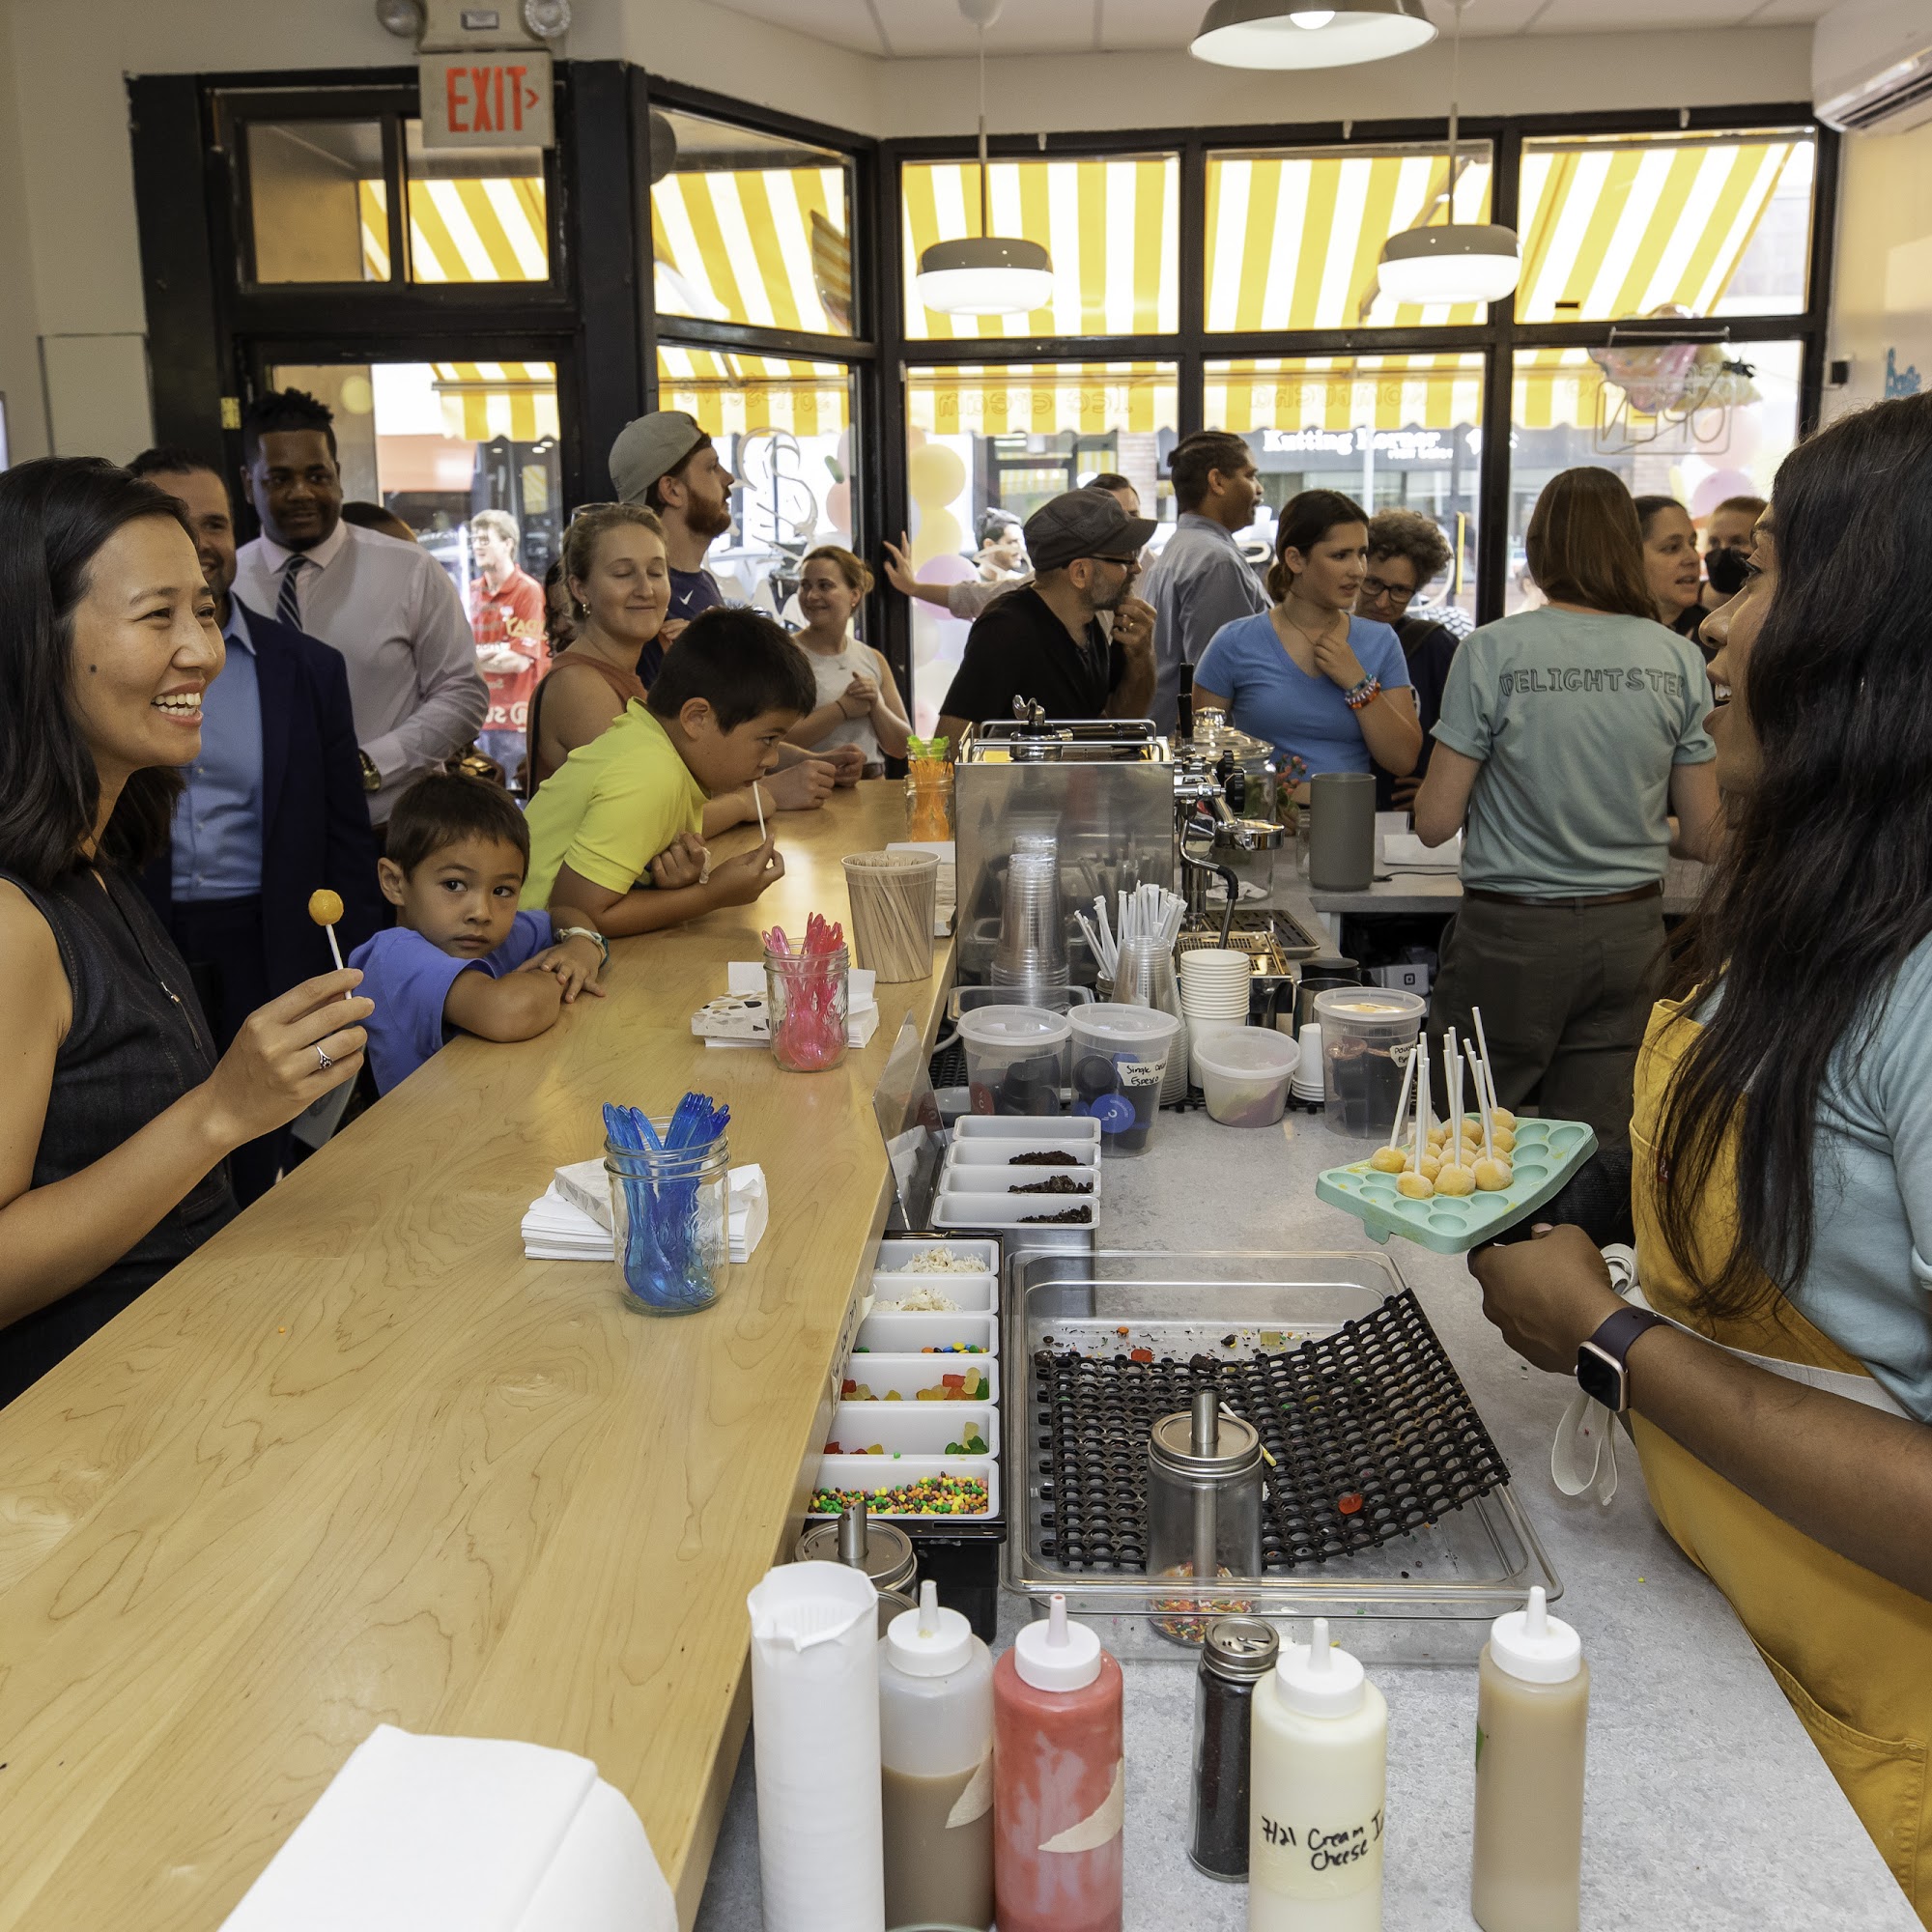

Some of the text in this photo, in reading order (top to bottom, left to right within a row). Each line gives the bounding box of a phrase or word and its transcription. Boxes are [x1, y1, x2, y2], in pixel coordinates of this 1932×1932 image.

[446, 66, 527, 132] EXIT
[1307, 1826, 1364, 1851] Cream
[1311, 1838, 1369, 1871] Cheese
